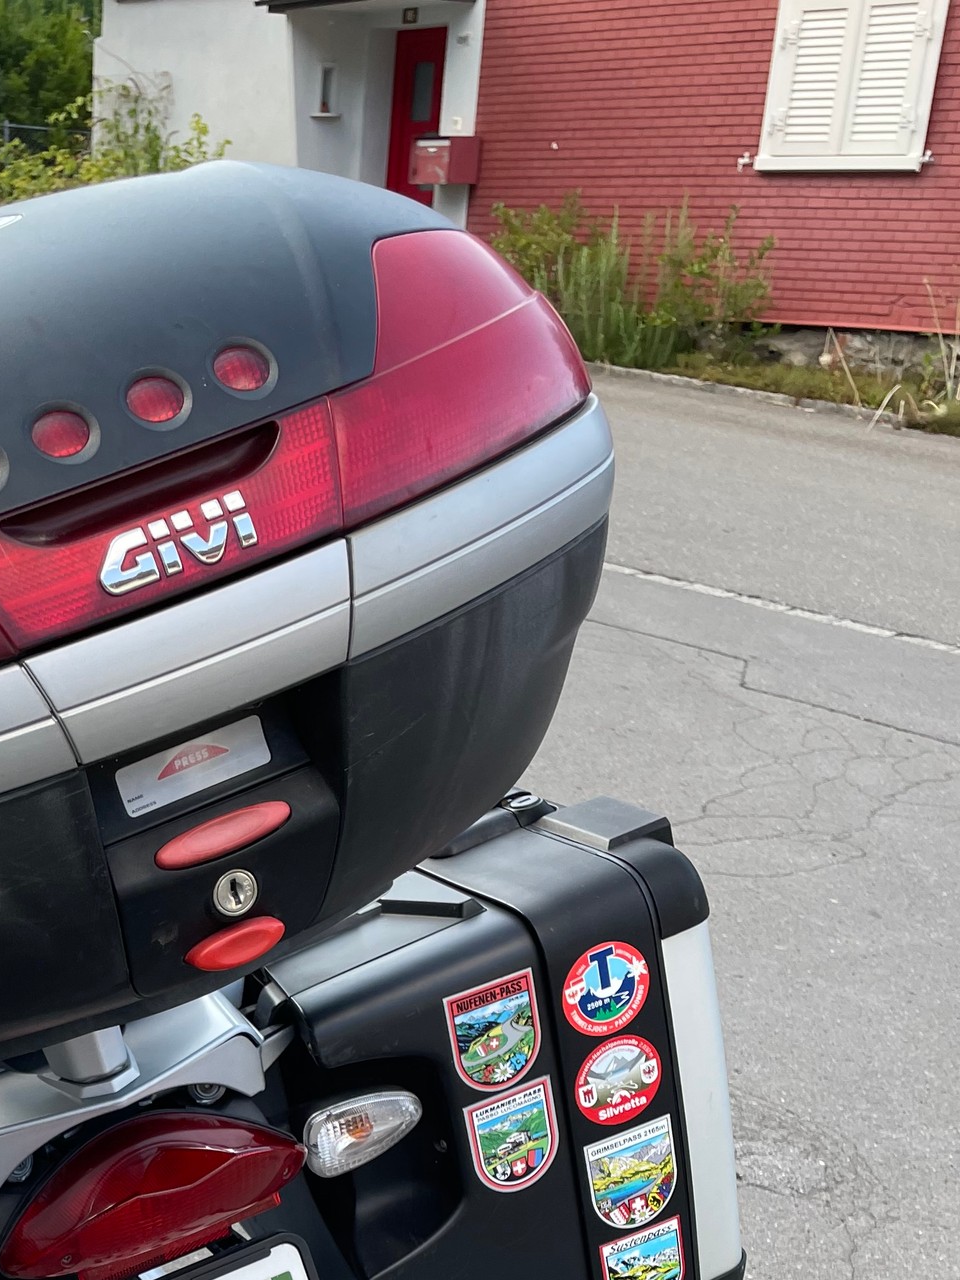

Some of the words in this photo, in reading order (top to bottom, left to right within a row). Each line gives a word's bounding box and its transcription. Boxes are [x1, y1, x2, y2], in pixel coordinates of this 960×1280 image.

[100, 489, 257, 595] GIVI
[173, 748, 209, 770] PRESS
[127, 793, 144, 804] NAME
[131, 801, 157, 815] ADDRESS
[456, 981, 523, 1014] NUFENEN-PASS
[475, 1097, 517, 1119] LUKMANIER
[523, 1087, 542, 1099] PASS
[598, 1095, 648, 1121] Silvretta
[591, 1133, 642, 1157] GRIMSELPASS
[609, 1223, 674, 1255] Sustenpass
